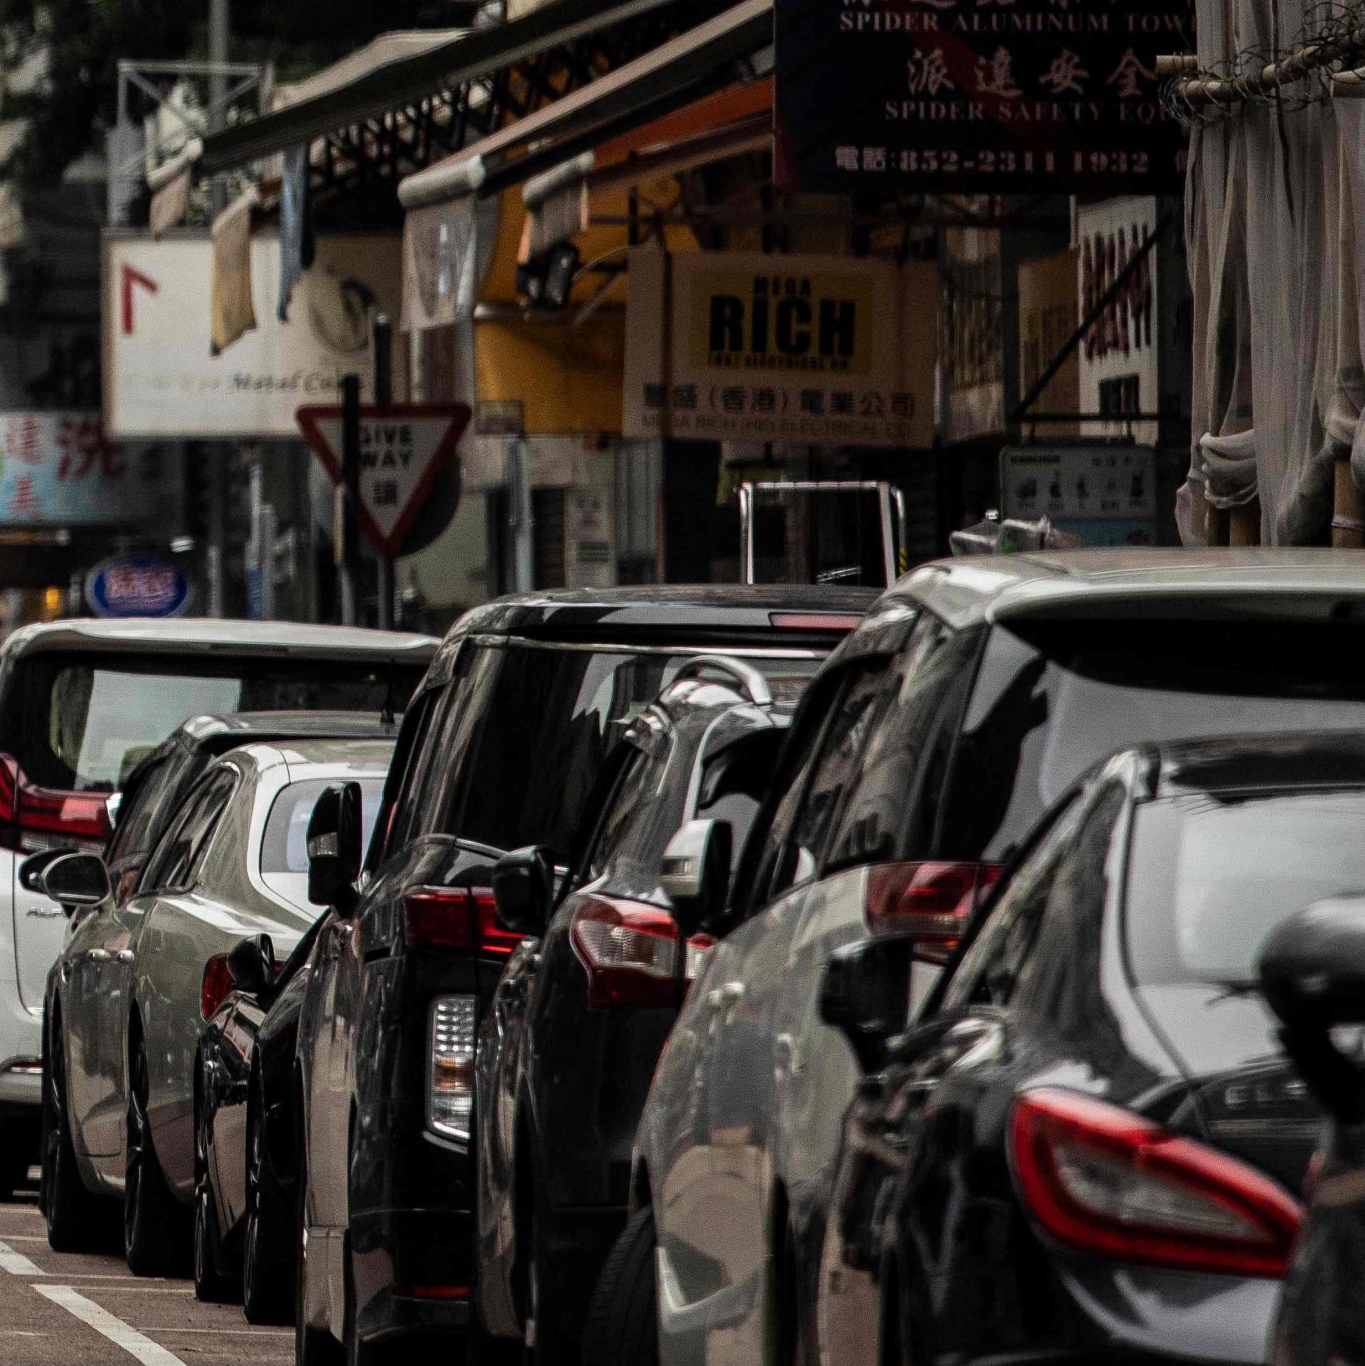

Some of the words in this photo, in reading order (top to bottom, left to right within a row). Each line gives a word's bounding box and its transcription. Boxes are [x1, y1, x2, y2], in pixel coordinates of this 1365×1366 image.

[840, 11, 939, 32] SPIDER
[953, 13, 1110, 33] ALUMINUM
[884, 99, 985, 121] SPIDER
[997, 101, 1103, 122] SAFETY
[1072, 150, 1150, 173] 1932
[709, 294, 856, 358] RICH
